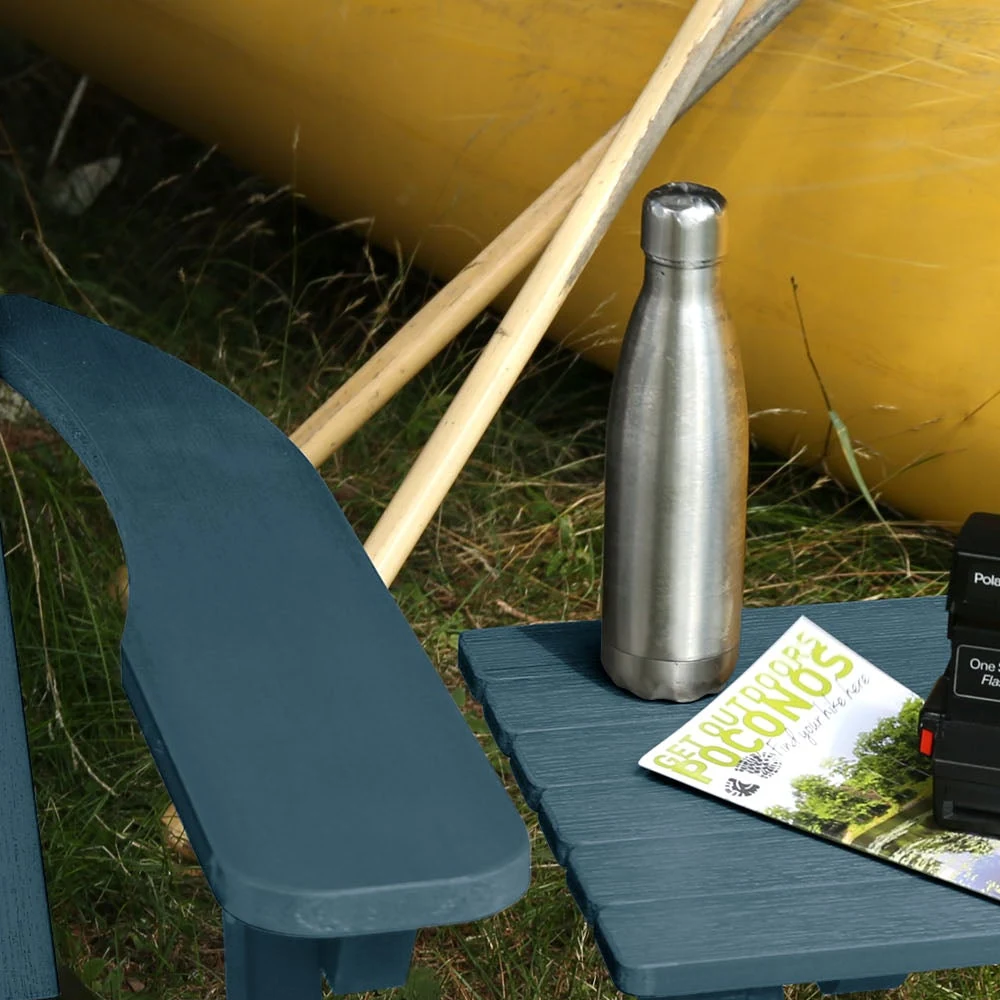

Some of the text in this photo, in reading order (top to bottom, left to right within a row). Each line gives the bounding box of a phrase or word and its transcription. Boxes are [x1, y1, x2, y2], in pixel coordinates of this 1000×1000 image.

[653, 631, 816, 770] GET OUTDOORS
[970, 658, 996, 673] One
[671, 638, 854, 785] POCONOS
[798, 715, 822, 746] your
